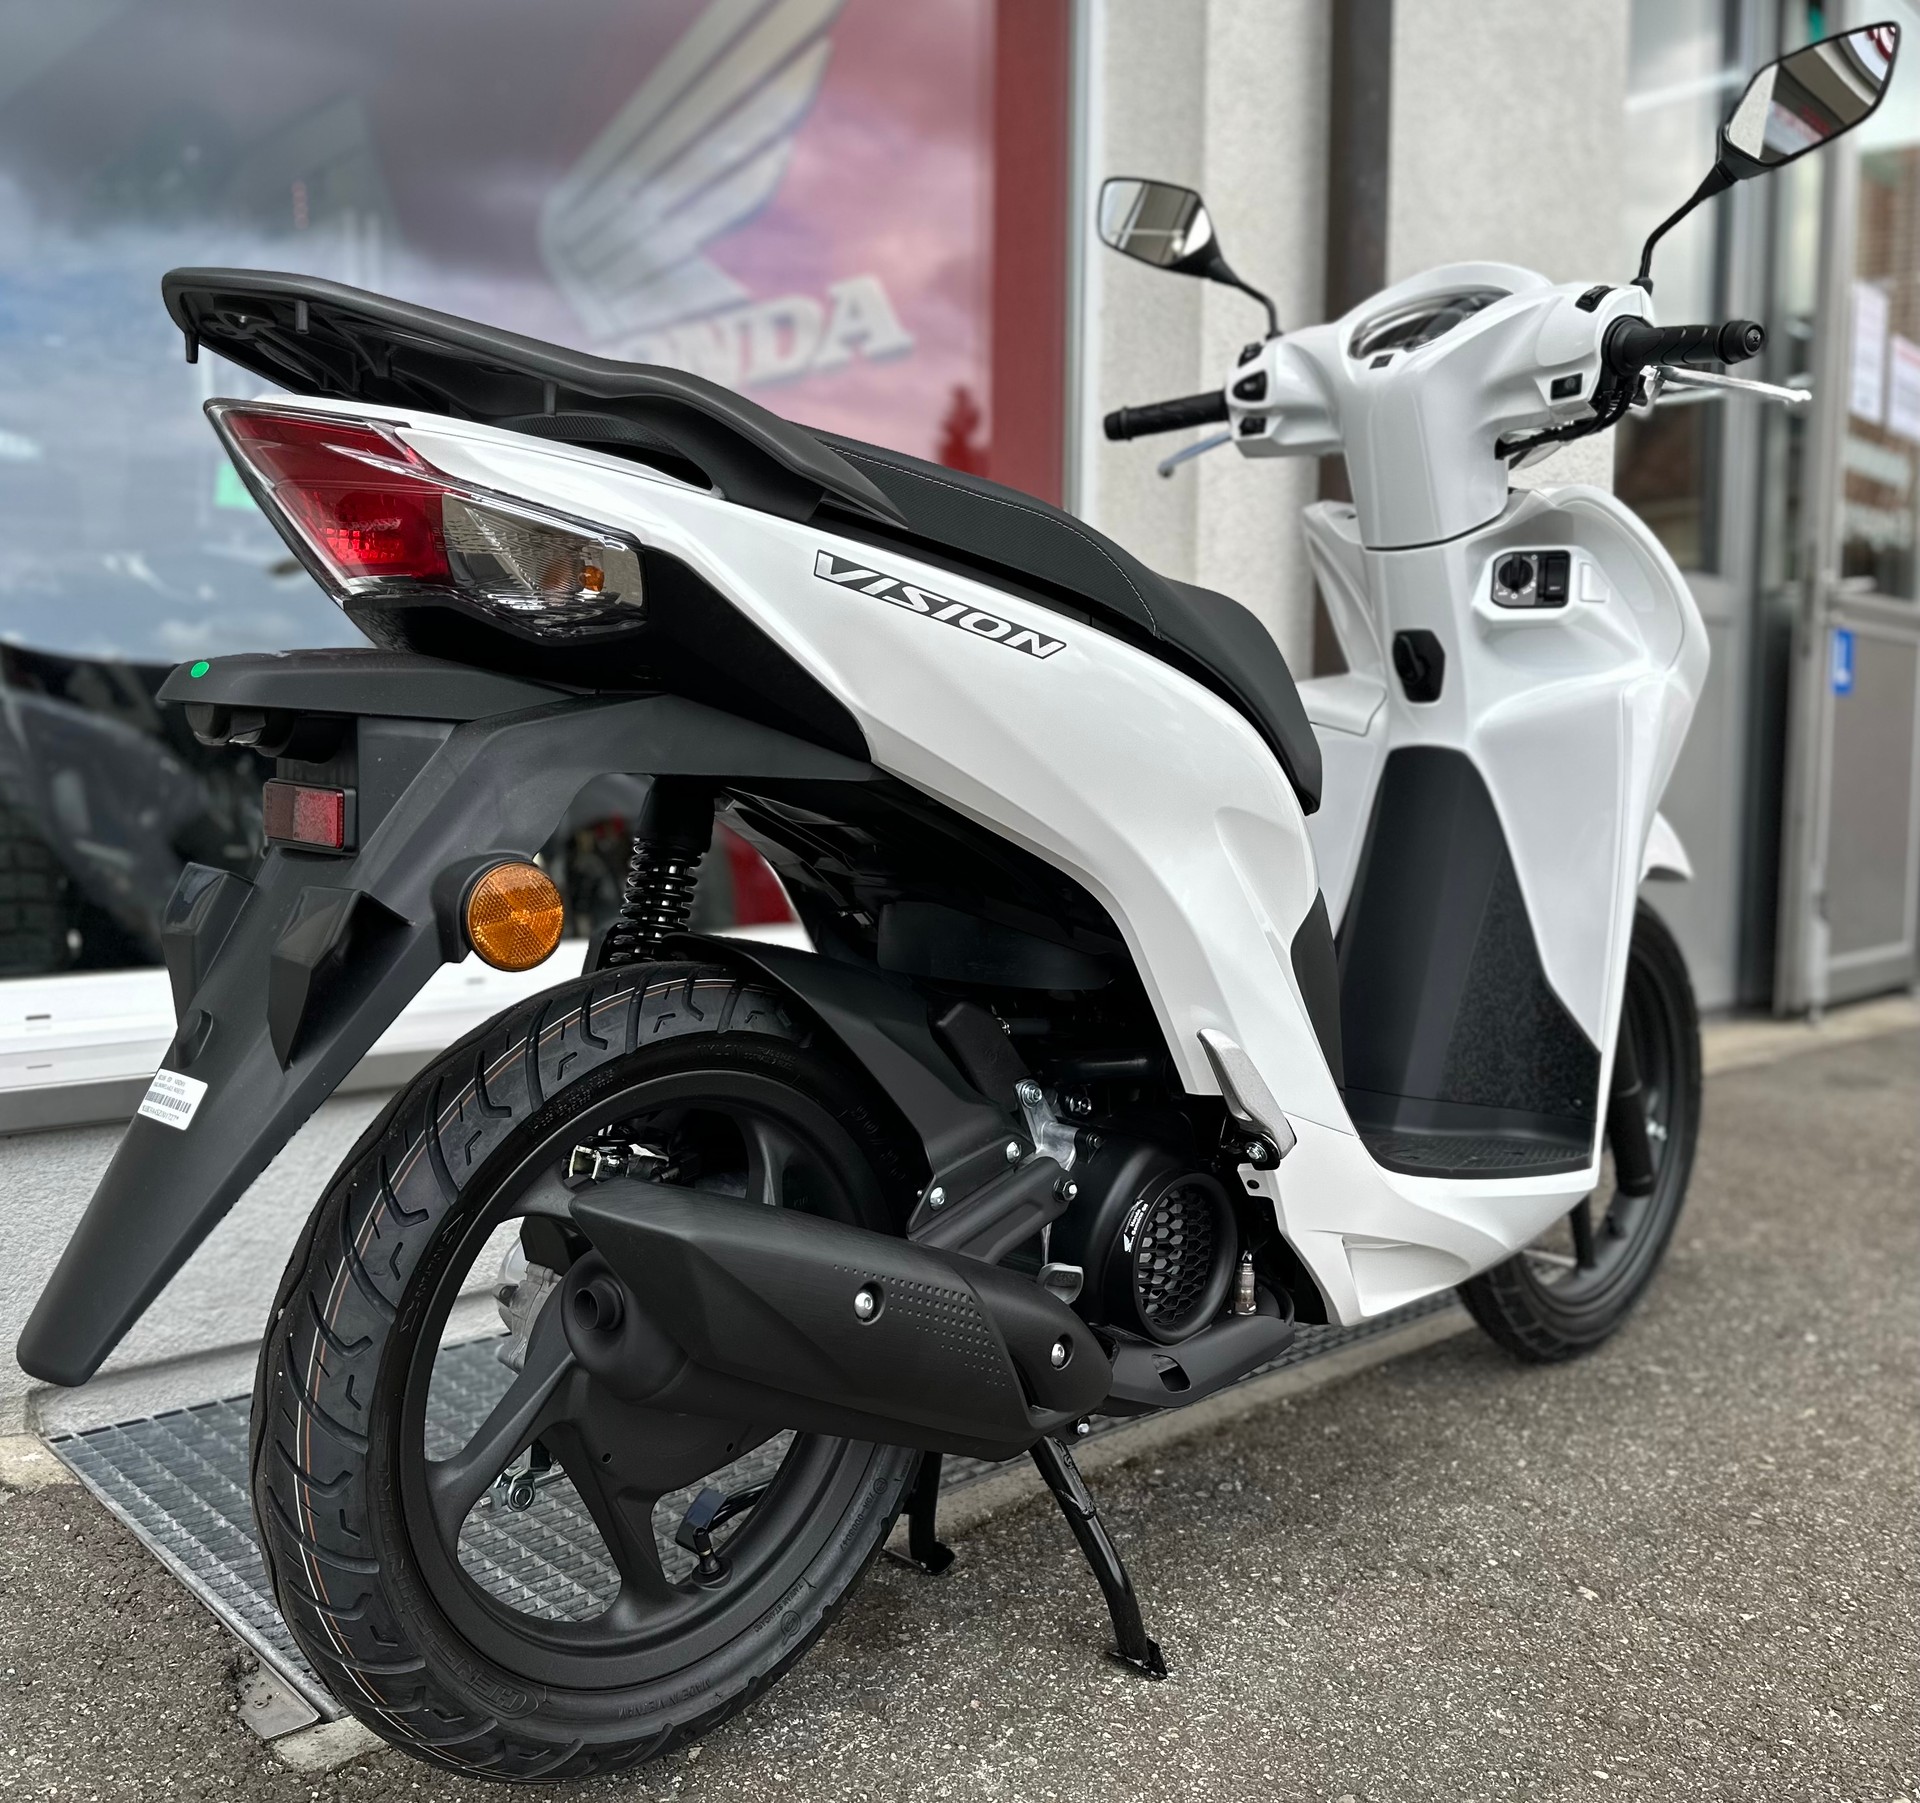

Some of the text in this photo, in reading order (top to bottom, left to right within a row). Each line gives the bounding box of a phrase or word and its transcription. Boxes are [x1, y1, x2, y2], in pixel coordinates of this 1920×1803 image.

[604, 274, 914, 392] NDA
[814, 549, 1067, 660] VISION
[415, 1245, 444, 1298] ROTATION
[618, 1678, 712, 1720] MADE IN VIETNAM
